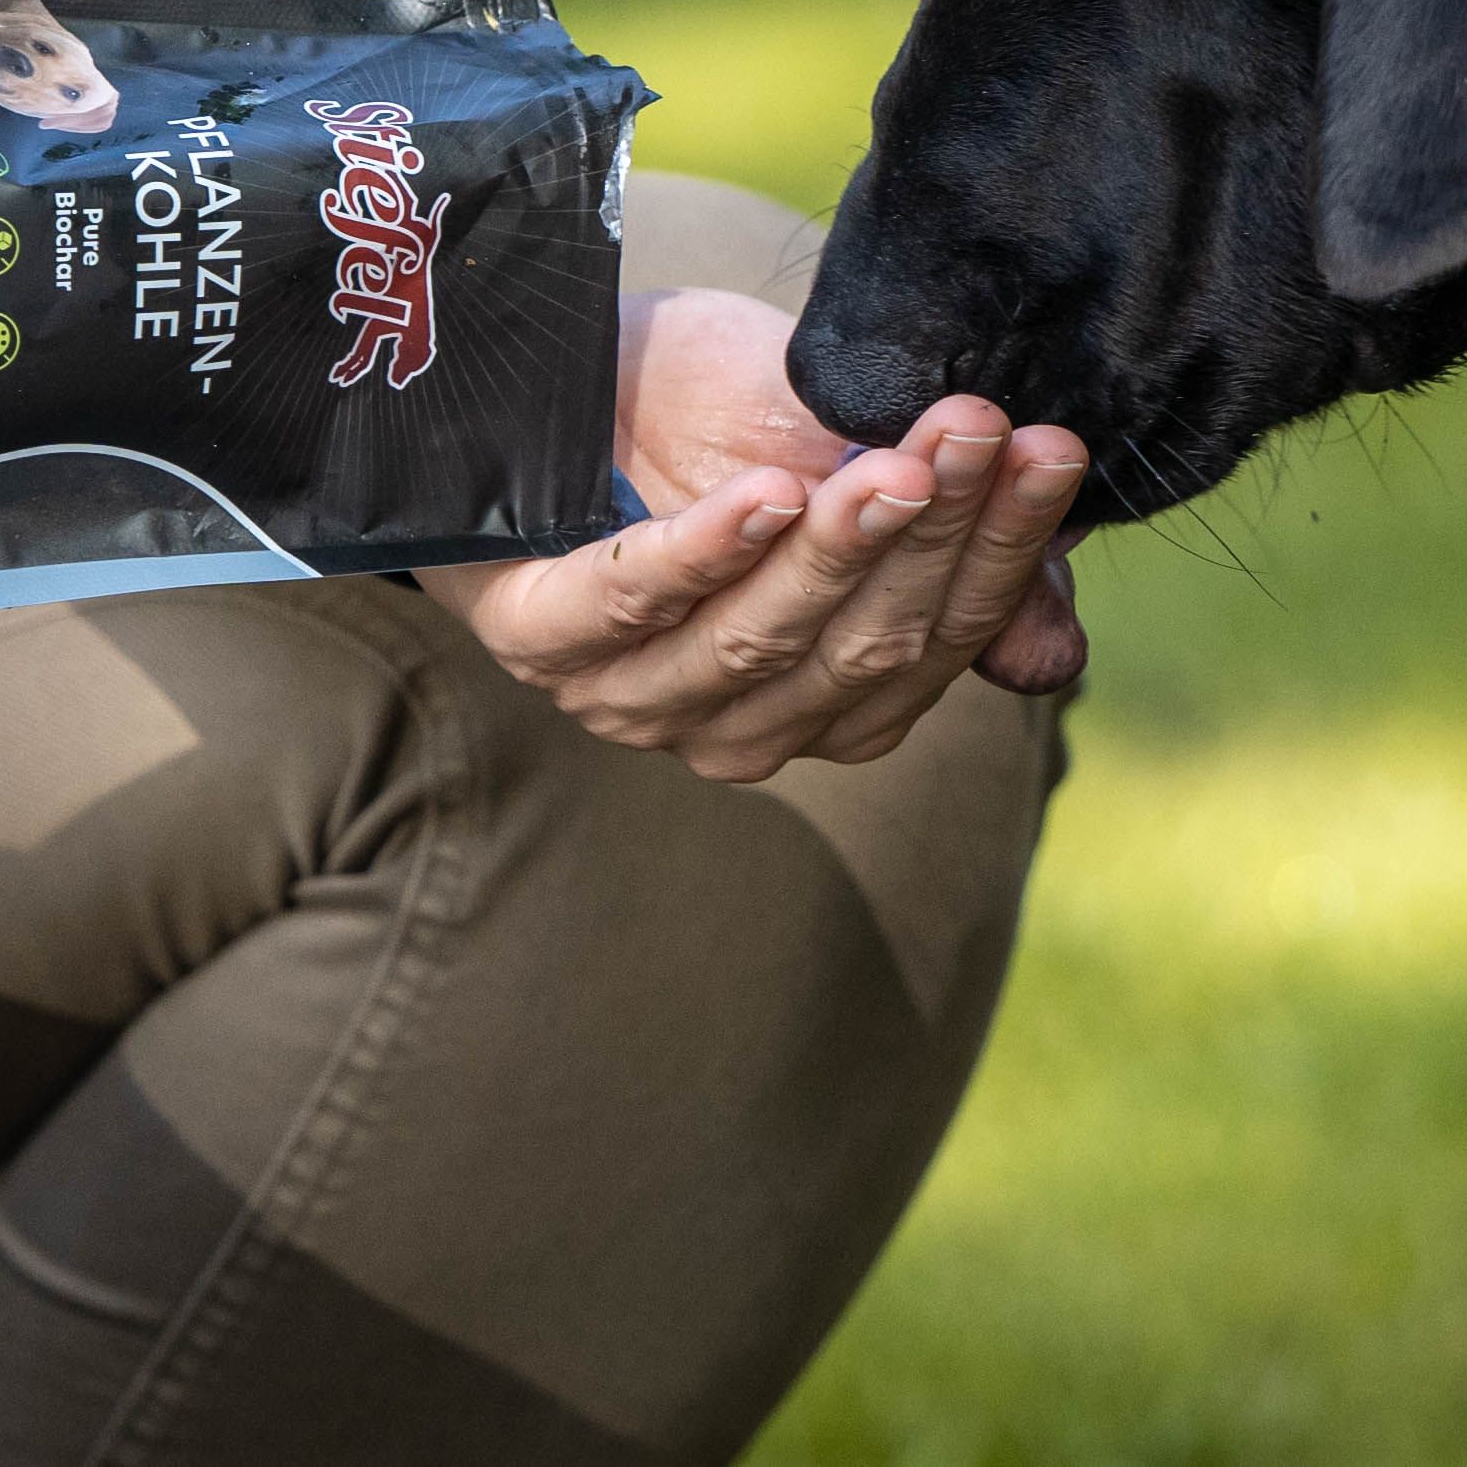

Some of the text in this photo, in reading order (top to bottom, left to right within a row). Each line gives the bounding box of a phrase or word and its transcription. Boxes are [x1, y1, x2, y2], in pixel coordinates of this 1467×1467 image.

[54, 192, 76, 291] Biochar
[81, 208, 102, 266] Pure
[123, 150, 180, 340] KOHLE
[166, 116, 241, 394] PFLANZEN-
[303, 100, 425, 327] Stiefel
